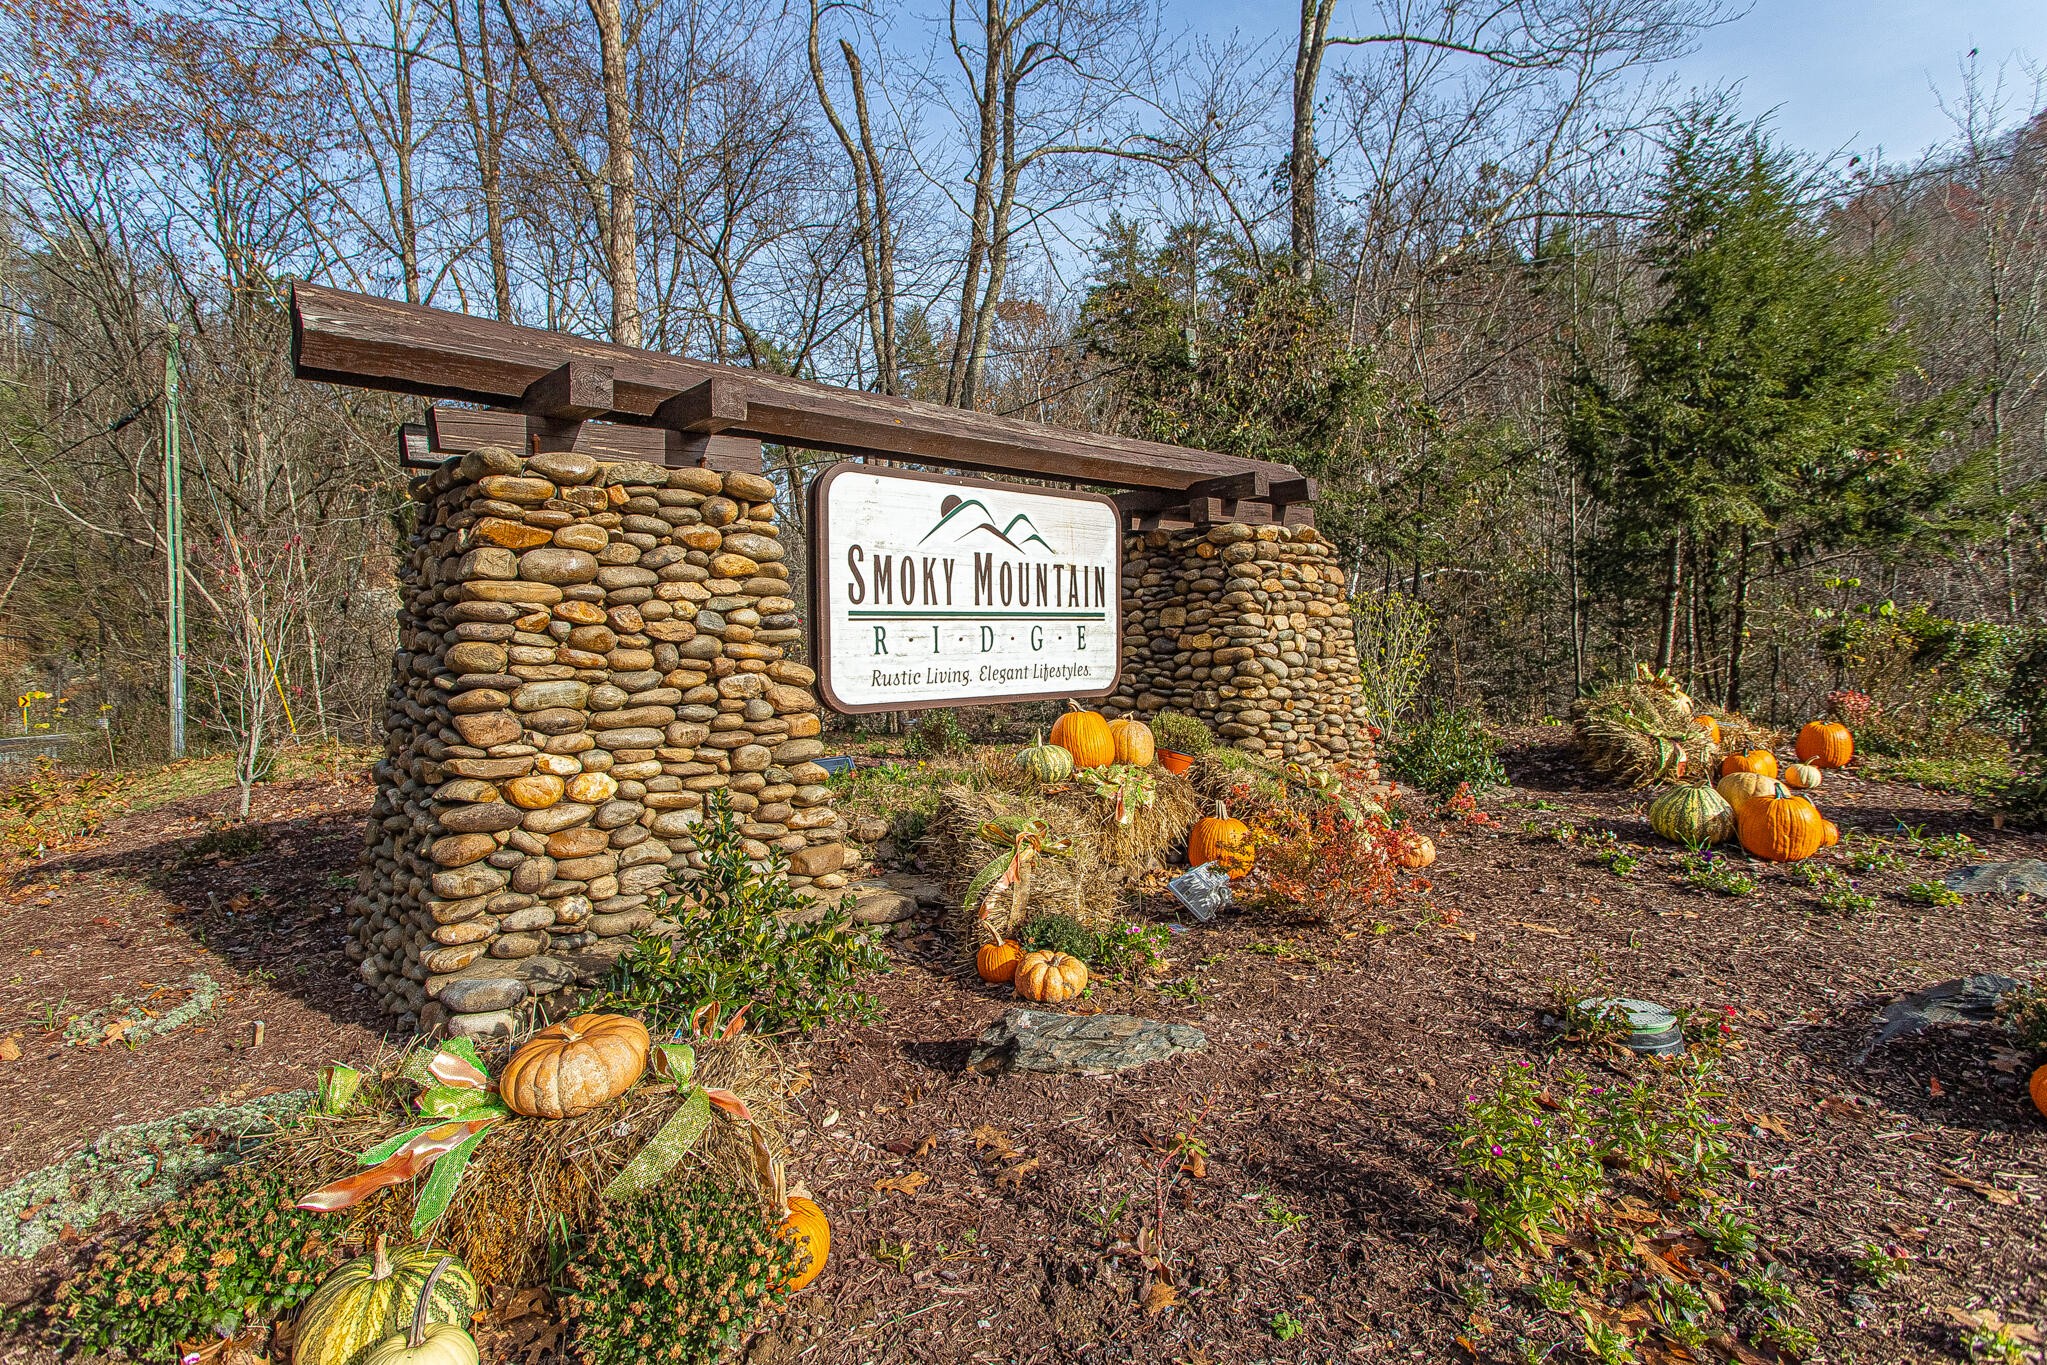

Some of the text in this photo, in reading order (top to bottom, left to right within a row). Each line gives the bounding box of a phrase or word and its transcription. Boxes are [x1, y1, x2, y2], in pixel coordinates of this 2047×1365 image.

[848, 544, 1106, 608] SMOKY MOUNTAIN
[871, 662, 1092, 687] Rustic Living. Elegant Lifestyles.
